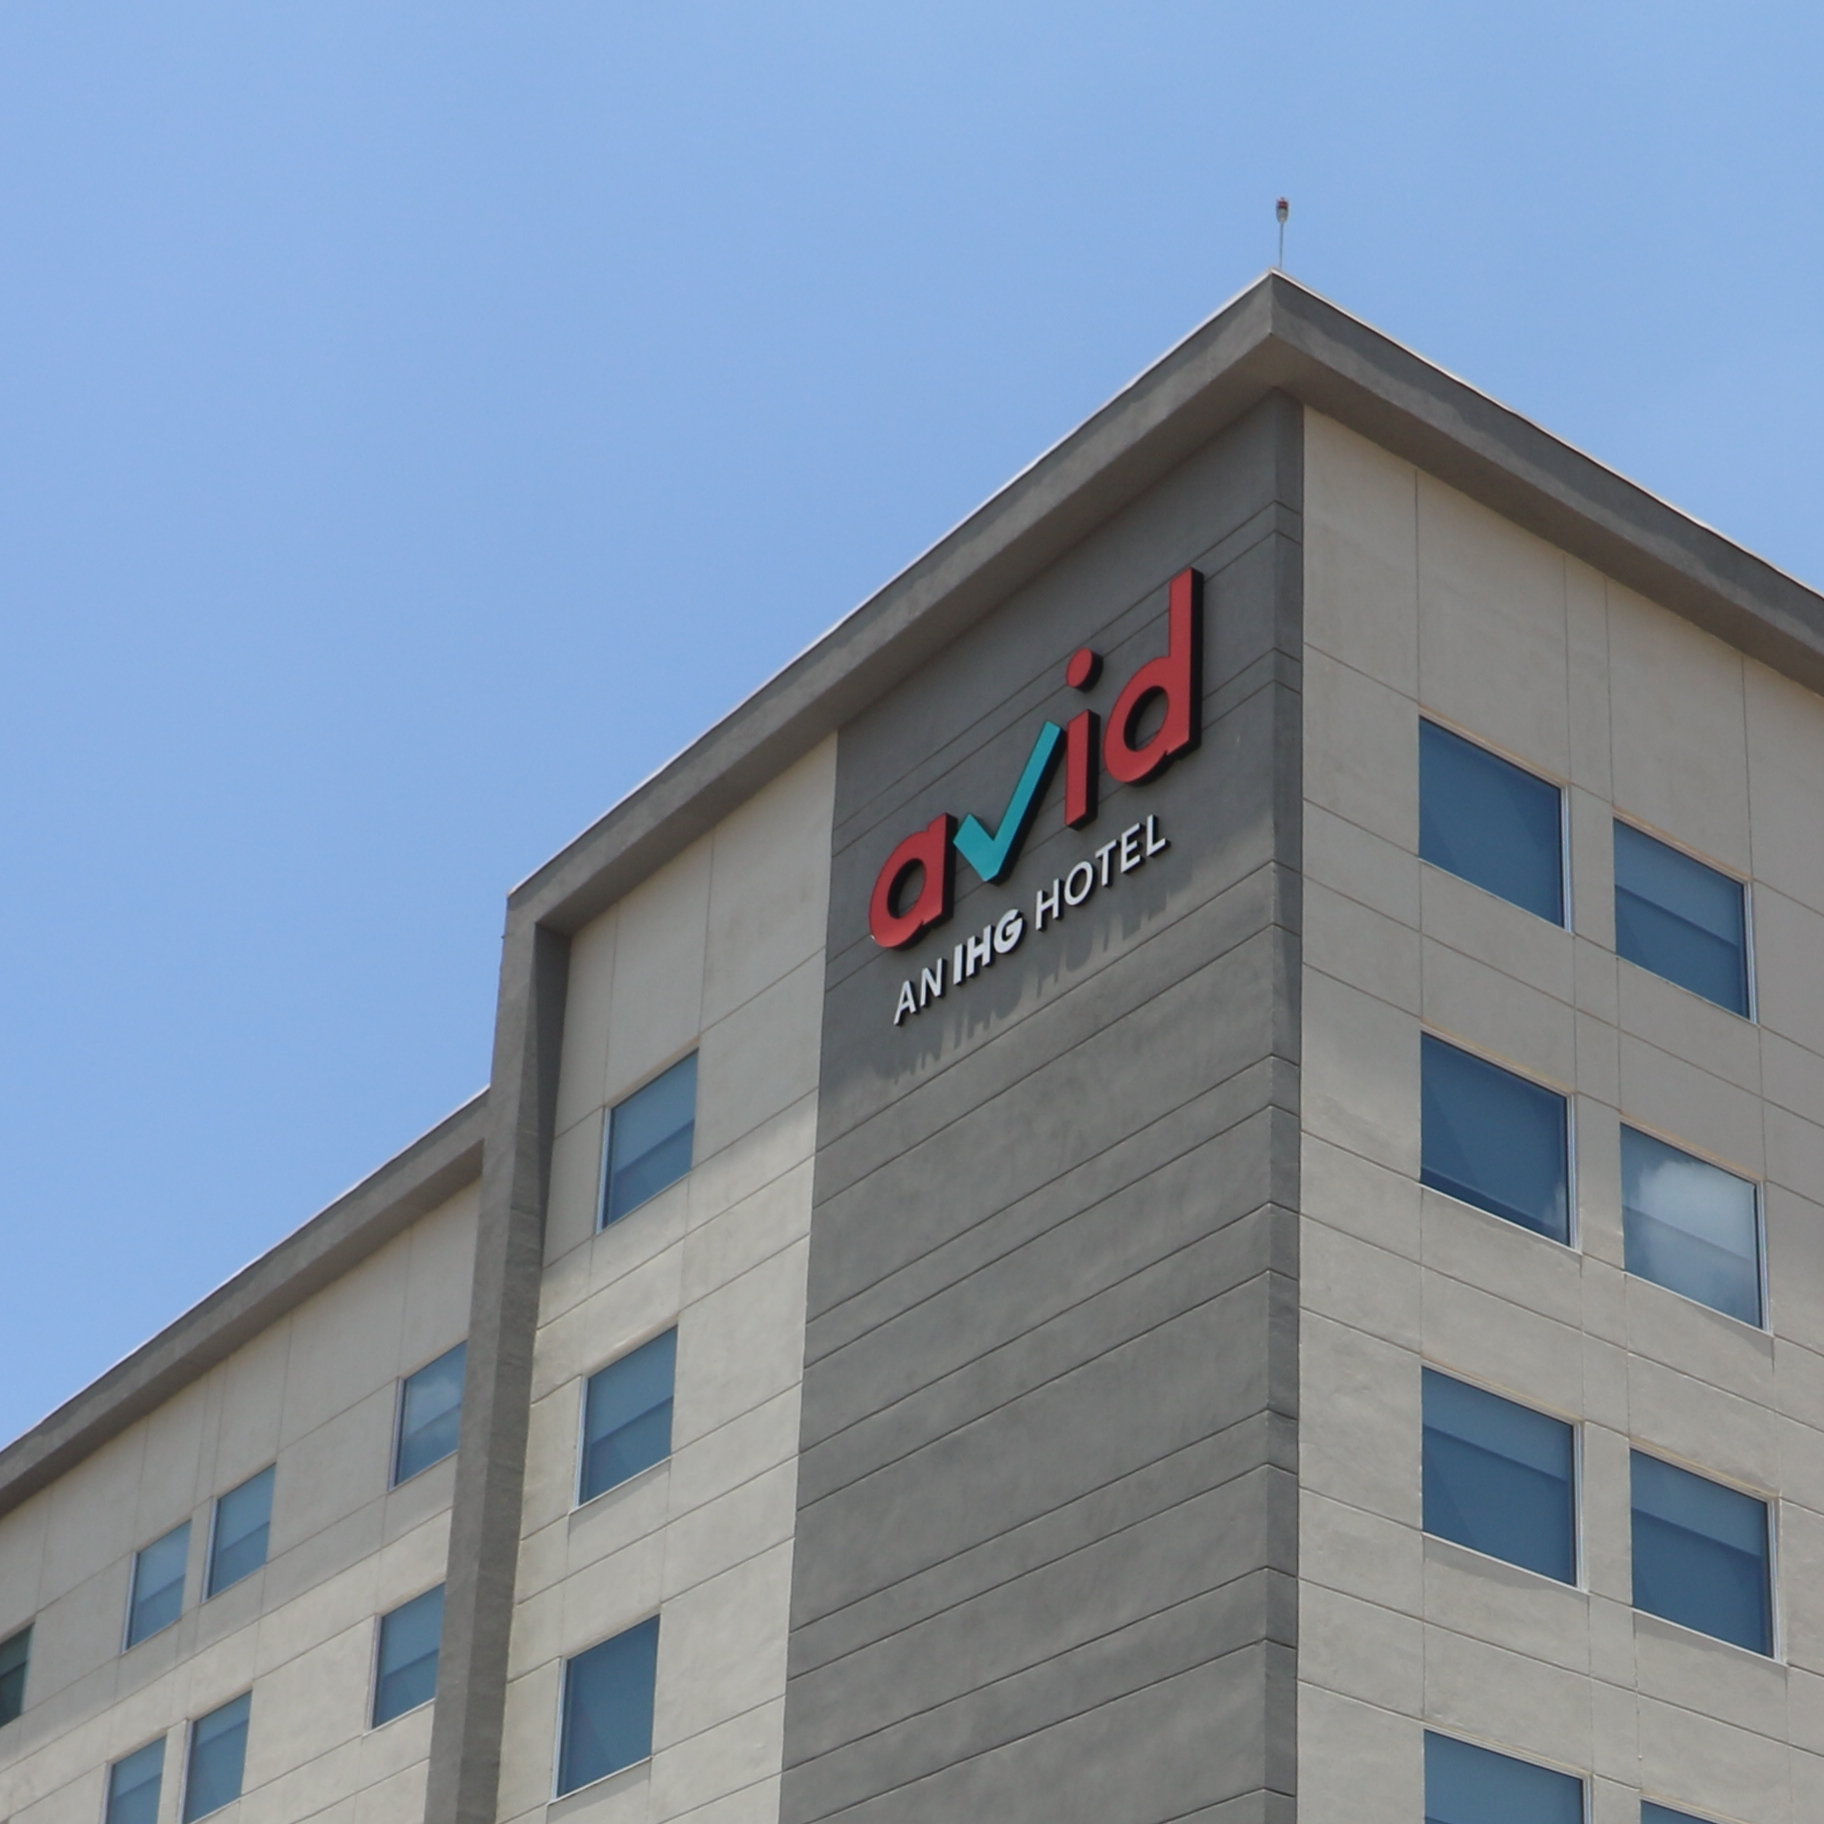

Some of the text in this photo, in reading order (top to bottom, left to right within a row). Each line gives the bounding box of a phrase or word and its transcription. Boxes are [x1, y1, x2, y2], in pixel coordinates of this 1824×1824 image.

[868, 567, 1203, 948] avid
[892, 814, 1167, 1026] AN IHG HOTEL
